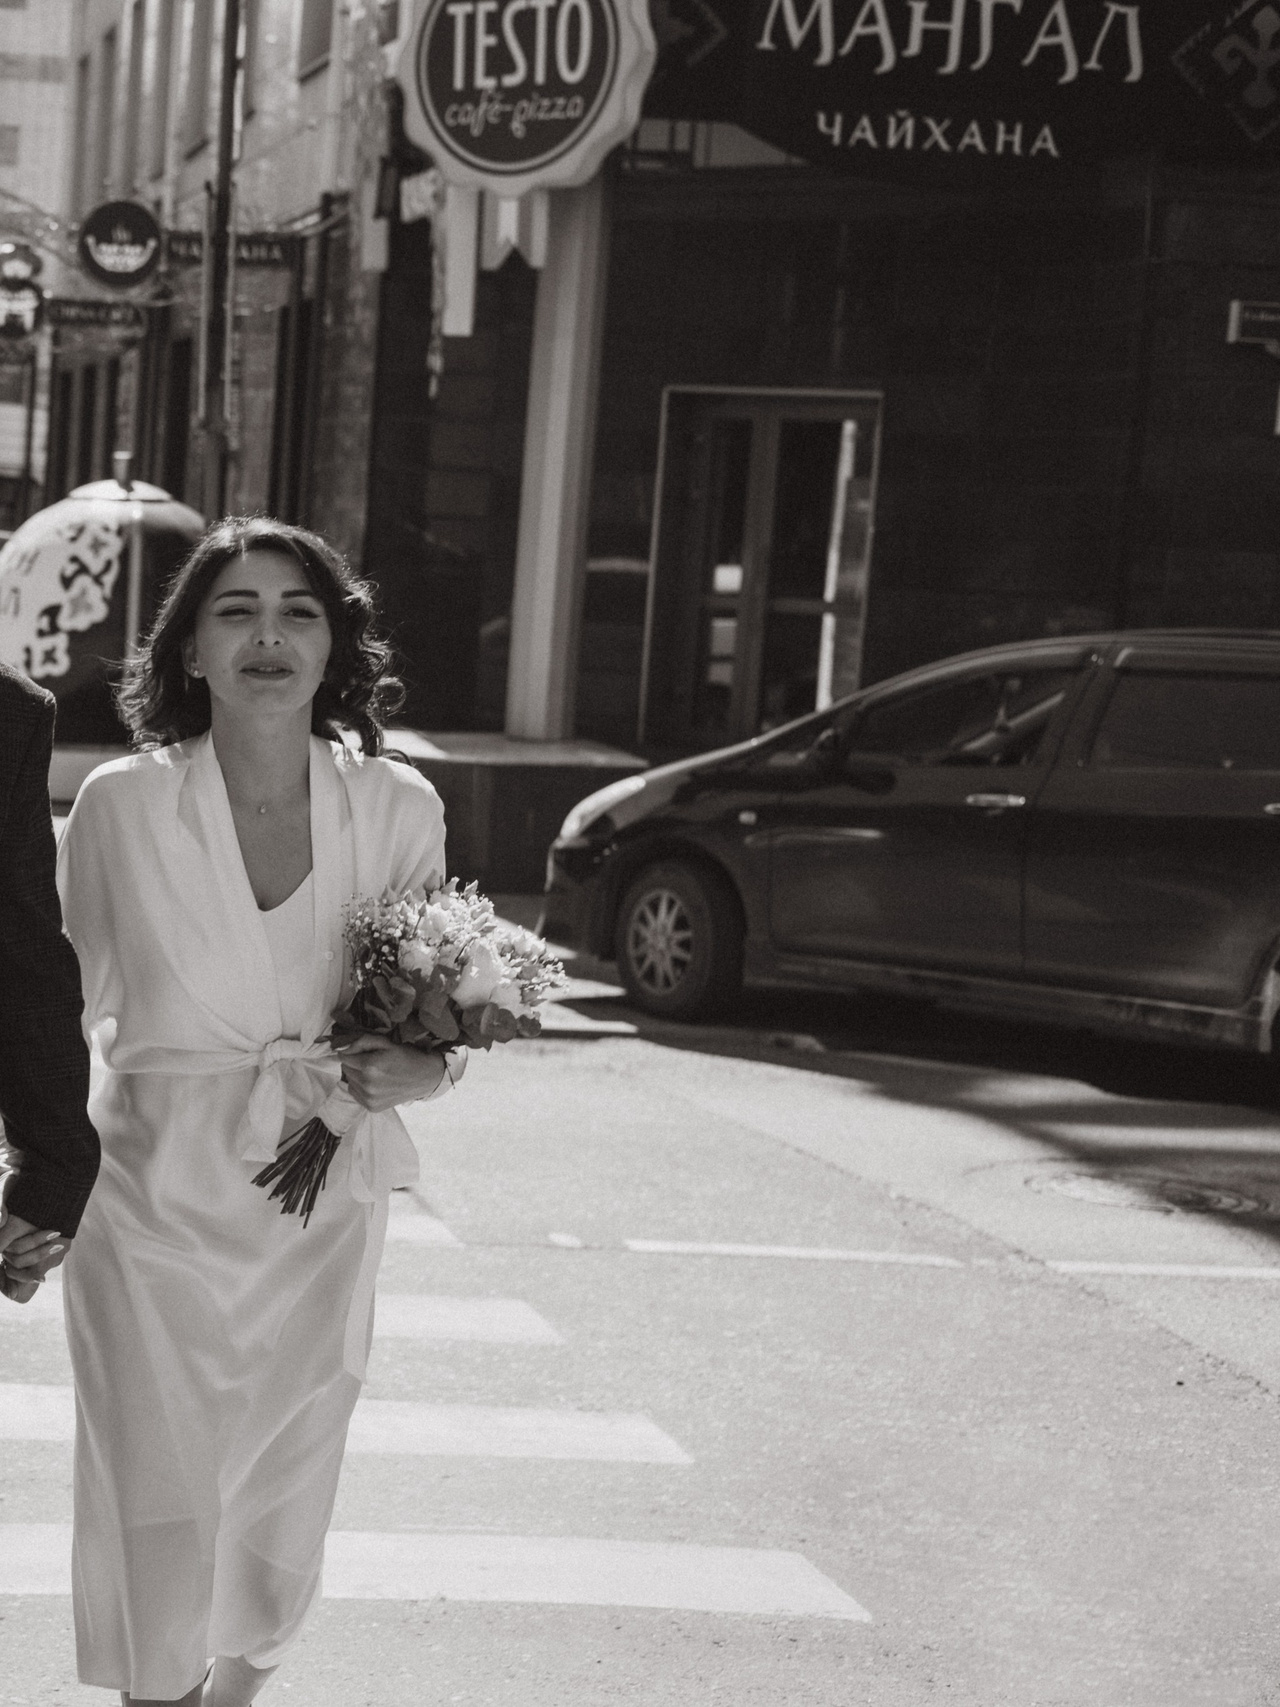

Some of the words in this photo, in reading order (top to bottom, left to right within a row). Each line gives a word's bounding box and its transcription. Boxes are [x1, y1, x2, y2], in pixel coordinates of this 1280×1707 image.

[446, 0, 593, 90] TESTO
[756, 0, 1144, 84] МАНГАЛ
[816, 109, 1060, 158] ЧАЙХАНА
[170, 241, 283, 260] ЧААНА
